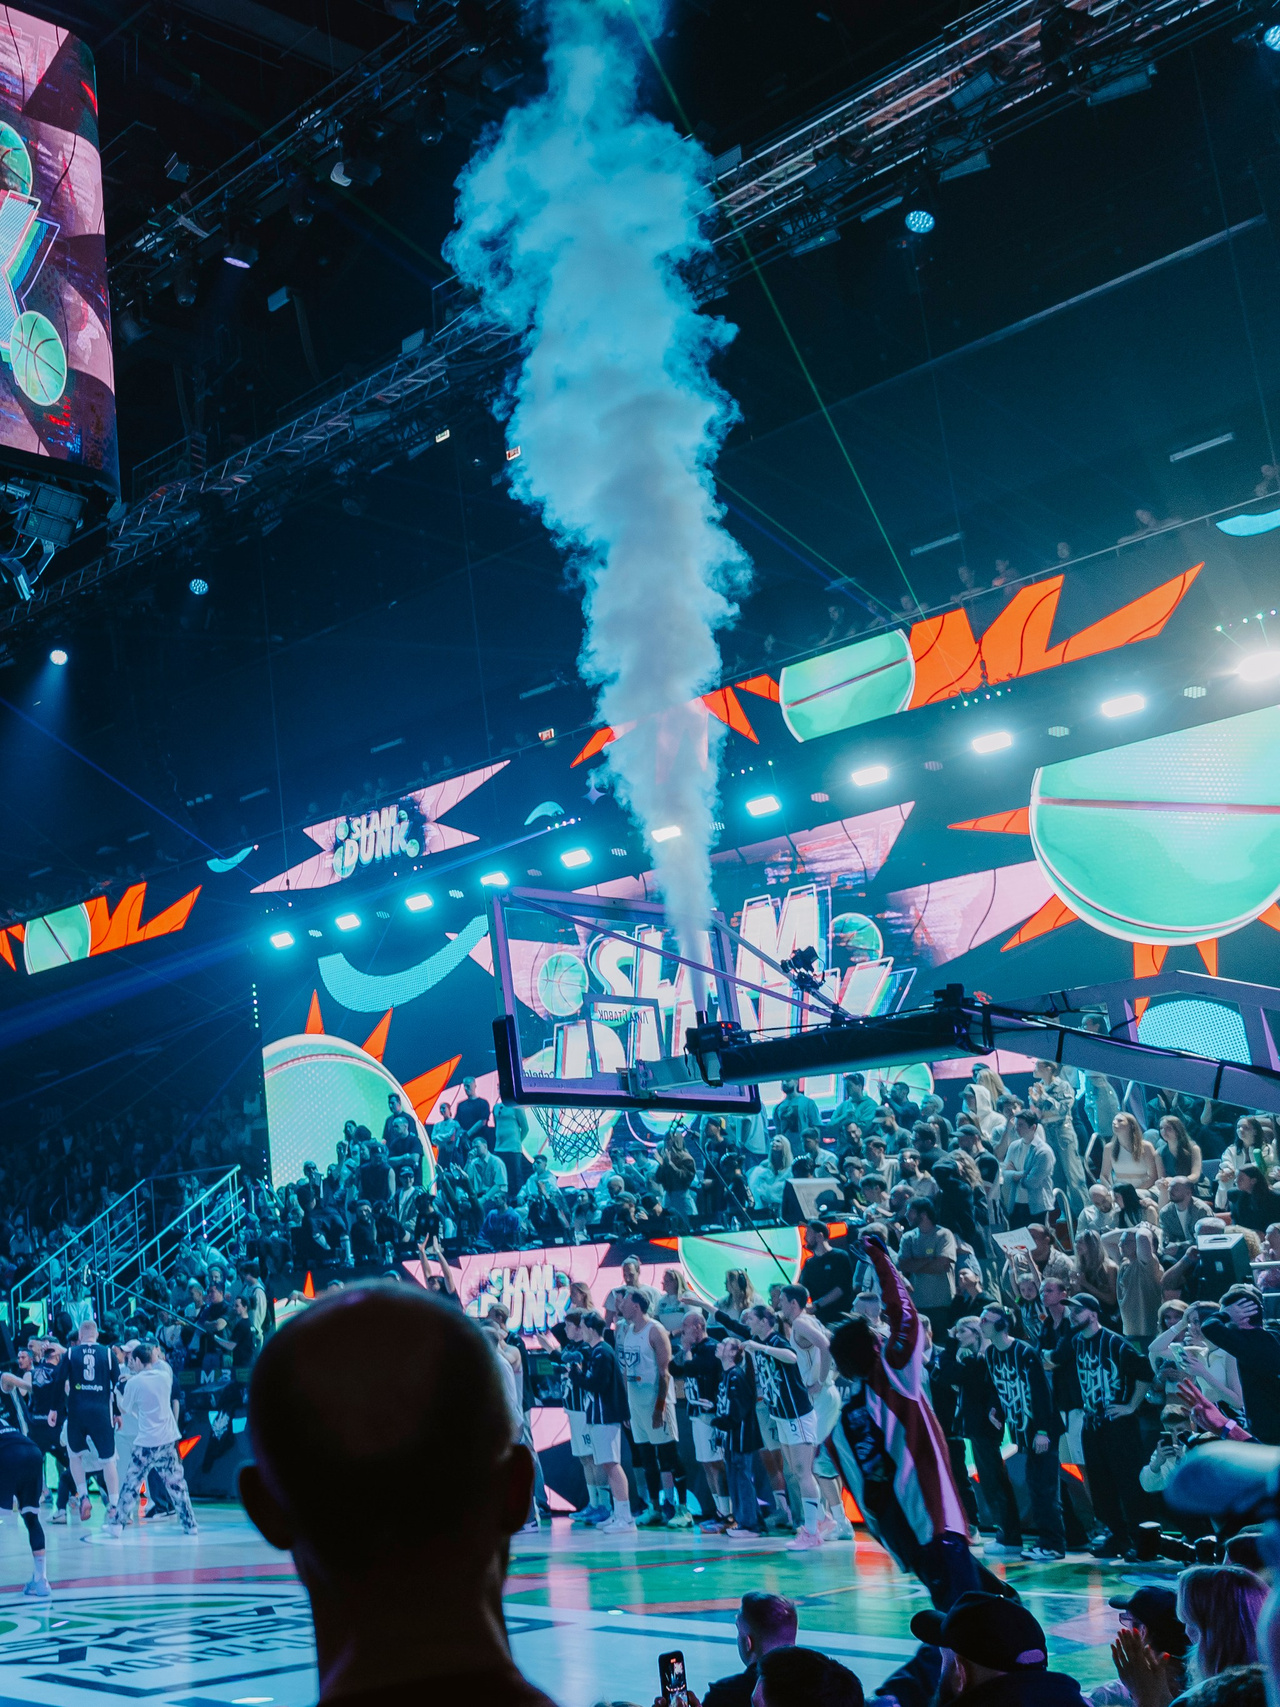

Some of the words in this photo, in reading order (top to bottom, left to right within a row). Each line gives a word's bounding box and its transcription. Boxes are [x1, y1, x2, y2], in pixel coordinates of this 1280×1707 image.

[350, 804, 398, 840] SLAM
[343, 820, 410, 867] DUNK
[488, 1264, 555, 1297] SLAM
[83, 1354, 95, 1381] 3
[790, 1421, 798, 1432] 5
